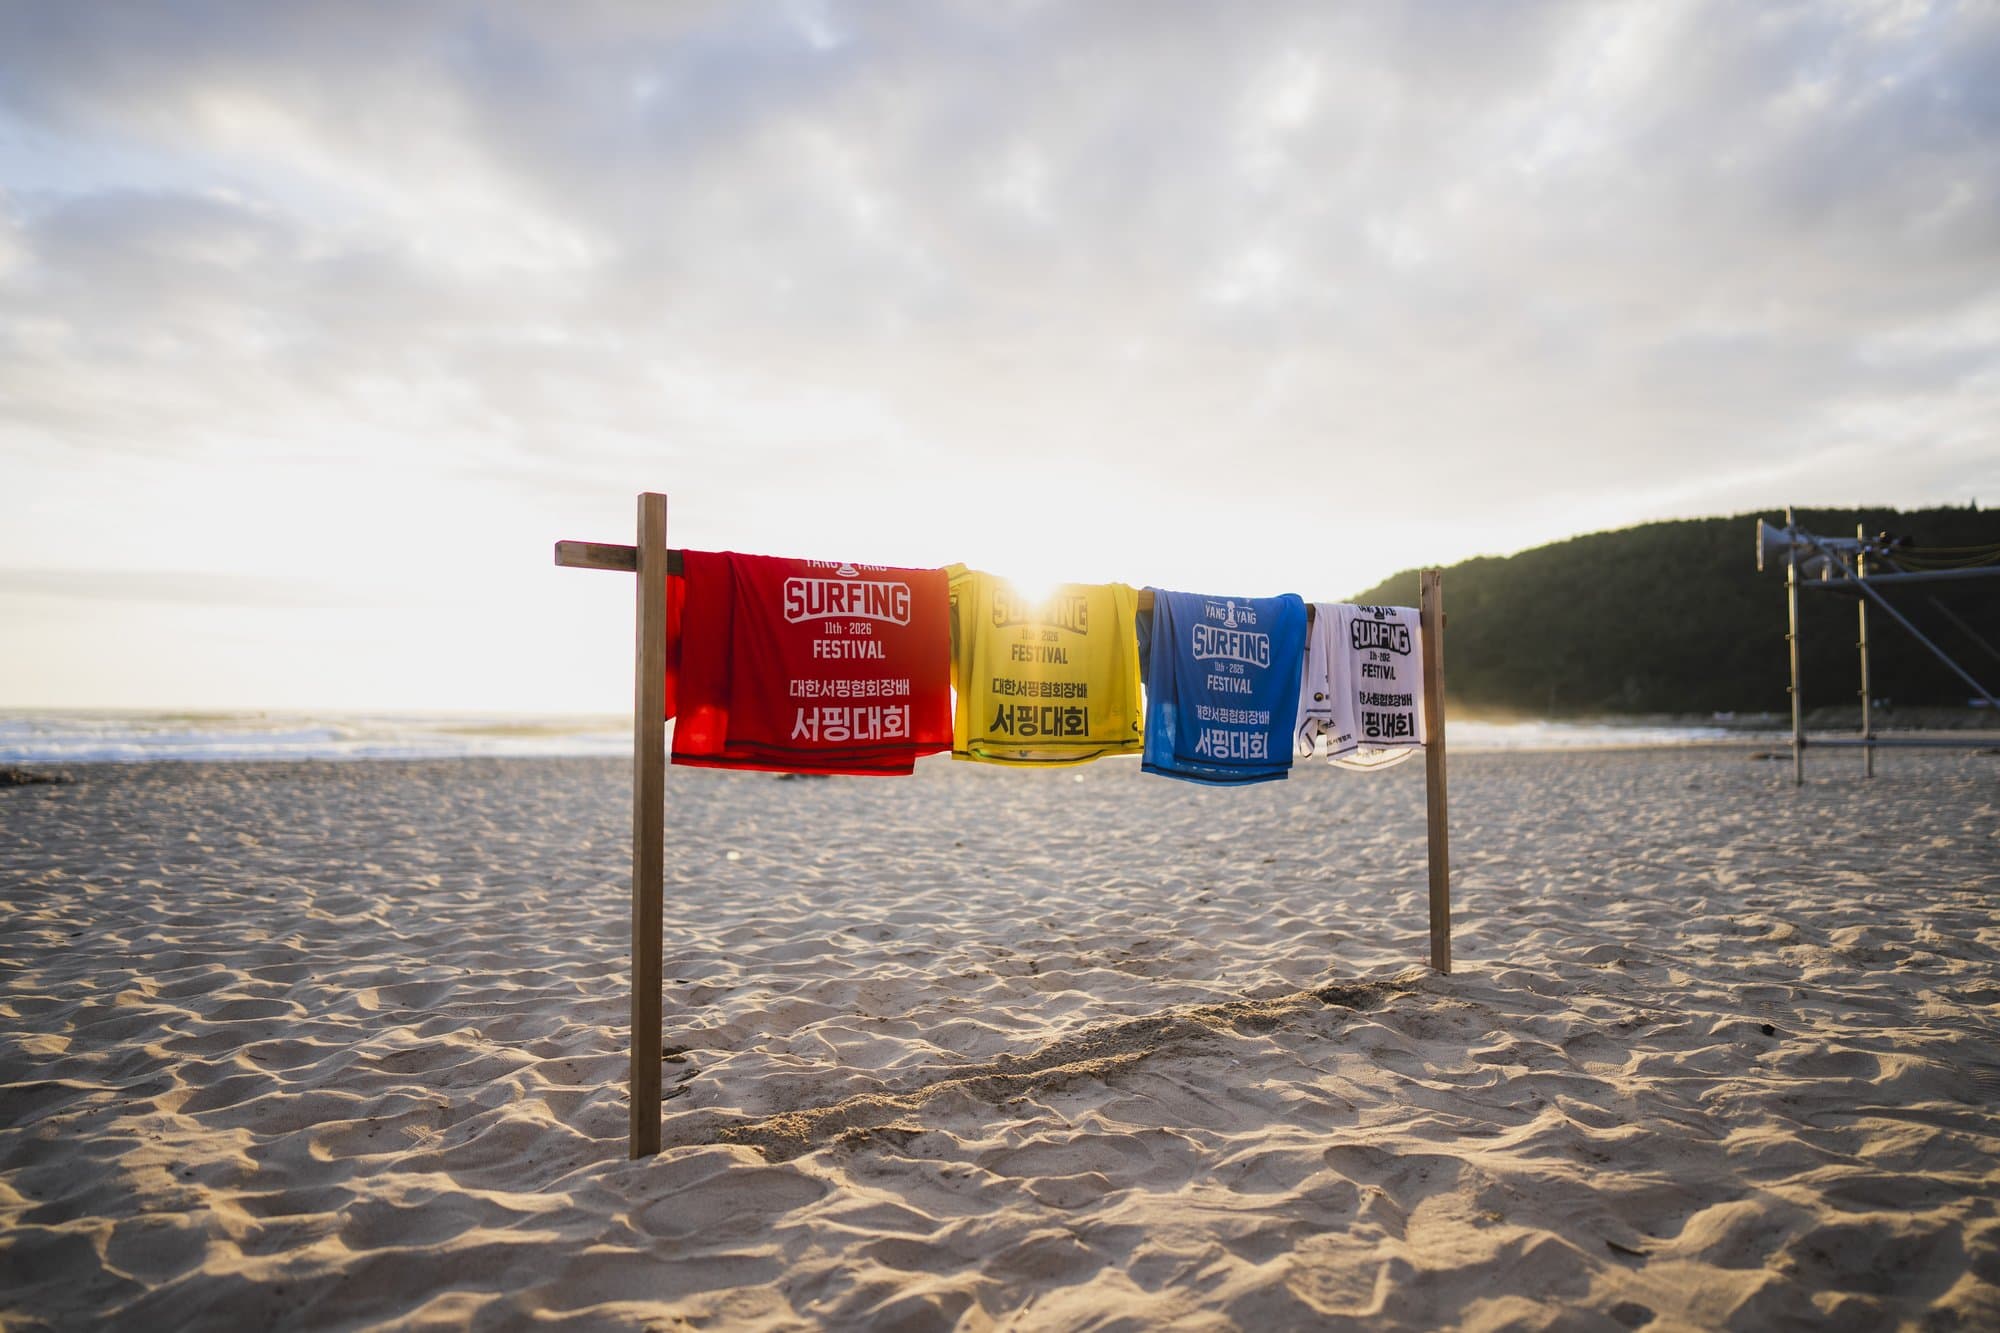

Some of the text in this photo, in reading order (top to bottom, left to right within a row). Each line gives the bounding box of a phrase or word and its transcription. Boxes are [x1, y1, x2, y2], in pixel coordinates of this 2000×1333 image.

[784, 577, 910, 625] SURFING
[991, 588, 1088, 634] SUING
[1205, 603, 1226, 620] YANG
[824, 622, 872, 635] 11th 2026
[813, 639, 885, 659] FESTIVAL
[1011, 643, 1068, 663] FESTIVAL
[1192, 623, 1270, 668] SURFING
[1362, 663, 1396, 679] FESTIVL
[789, 679, 909, 697] 대한서핑협회장배
[992, 677, 1087, 698] 대한서핑협회장배
[1207, 674, 1252, 693] FESTIVAL
[791, 704, 909, 741] 서핑대회
[989, 703, 1089, 736] 서핑대회
[1361, 711, 1414, 737] 핑대회
[1194, 727, 1268, 759] 서핑대회
